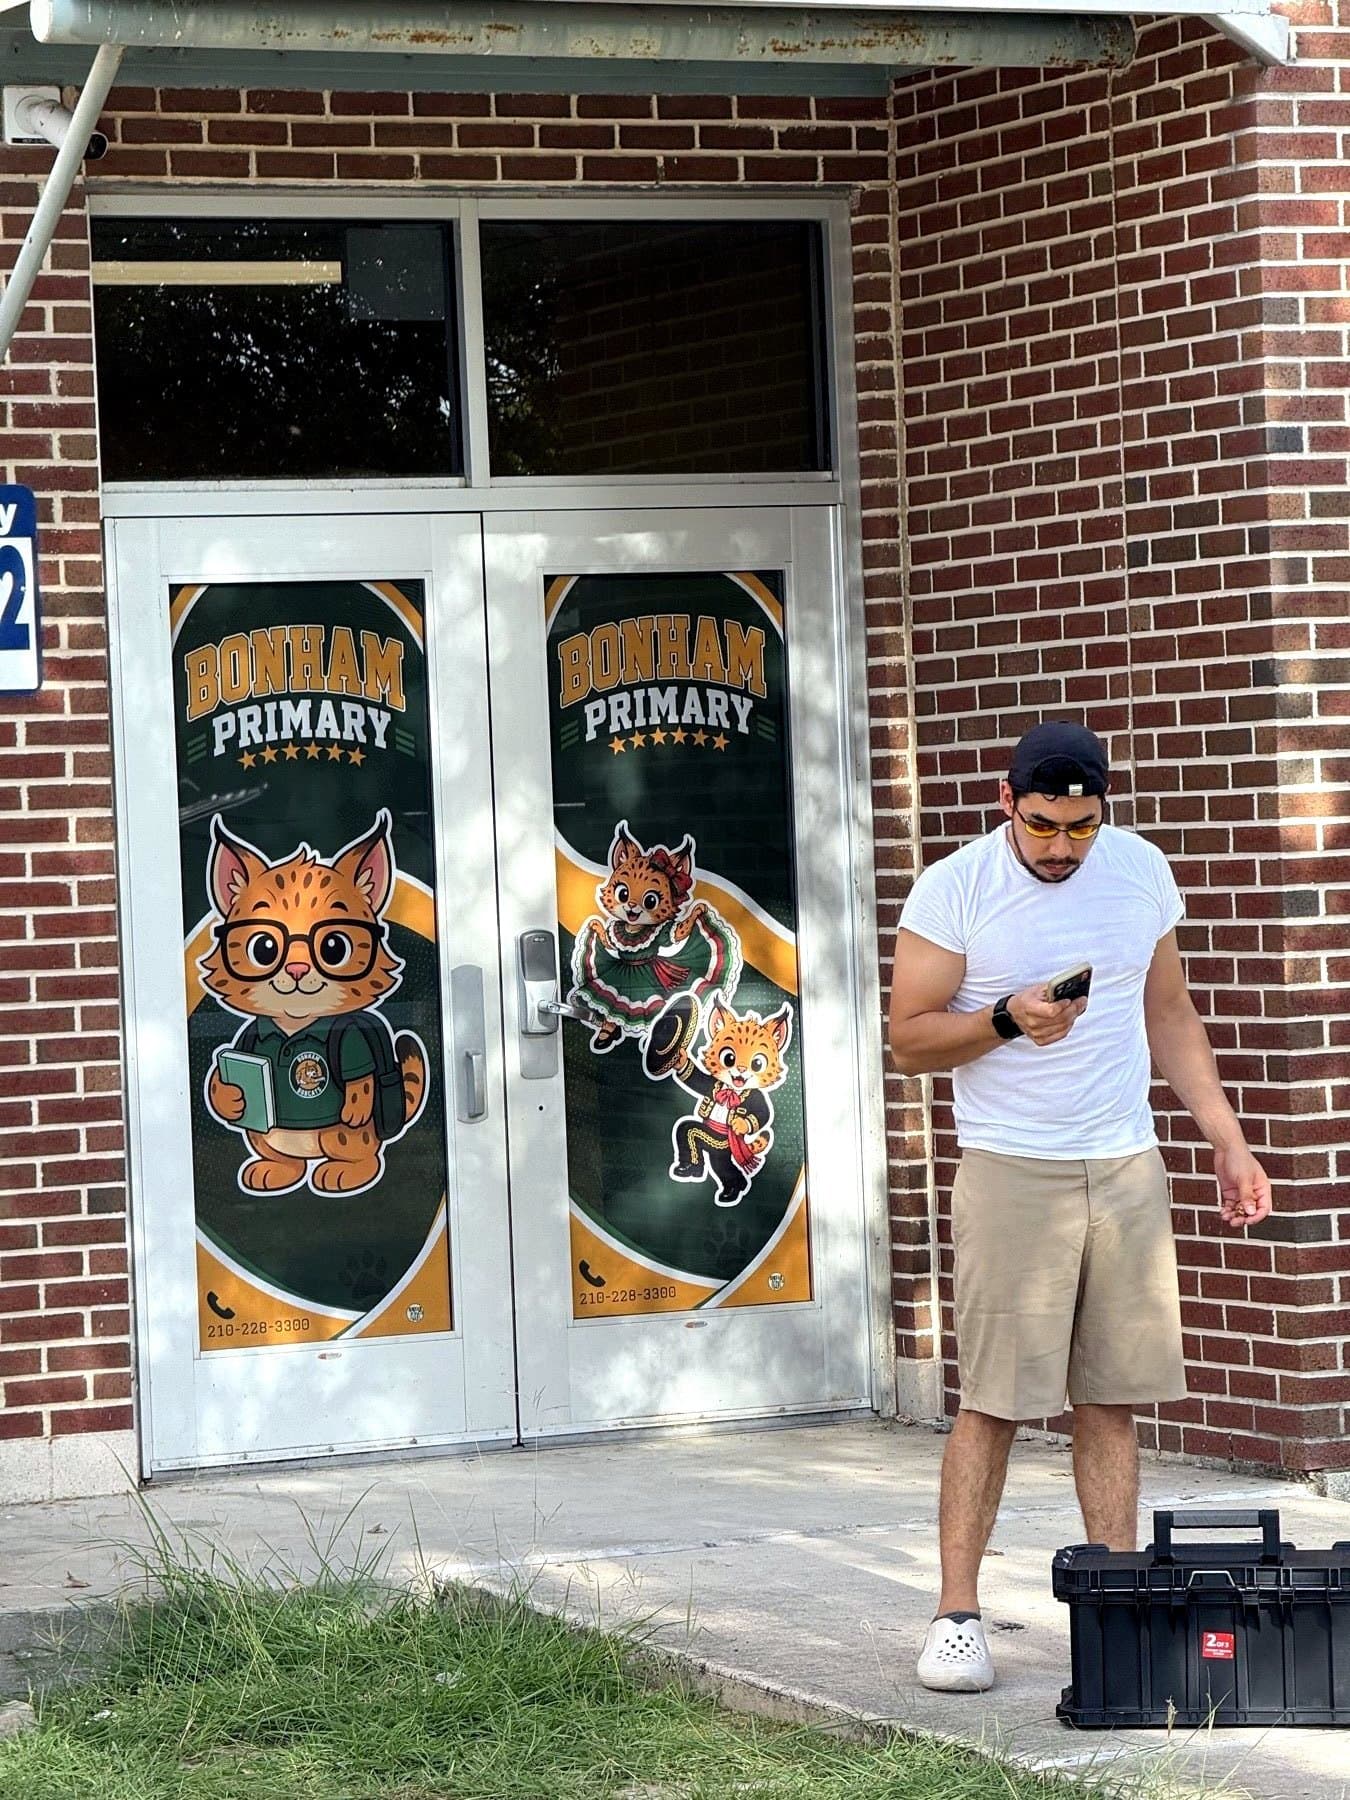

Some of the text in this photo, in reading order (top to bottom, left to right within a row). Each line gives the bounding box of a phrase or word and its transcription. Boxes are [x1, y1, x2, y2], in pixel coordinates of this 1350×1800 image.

[184, 624, 406, 723] BONHAM
[558, 614, 767, 709] BONHAM
[212, 699, 391, 757] PRIMARY
[584, 686, 753, 742] PRIMARY
[580, 1286, 676, 1305] 210-228-3300
[207, 1318, 310, 1338] 210-228-3300
[1206, 1633, 1216, 1647] 2
